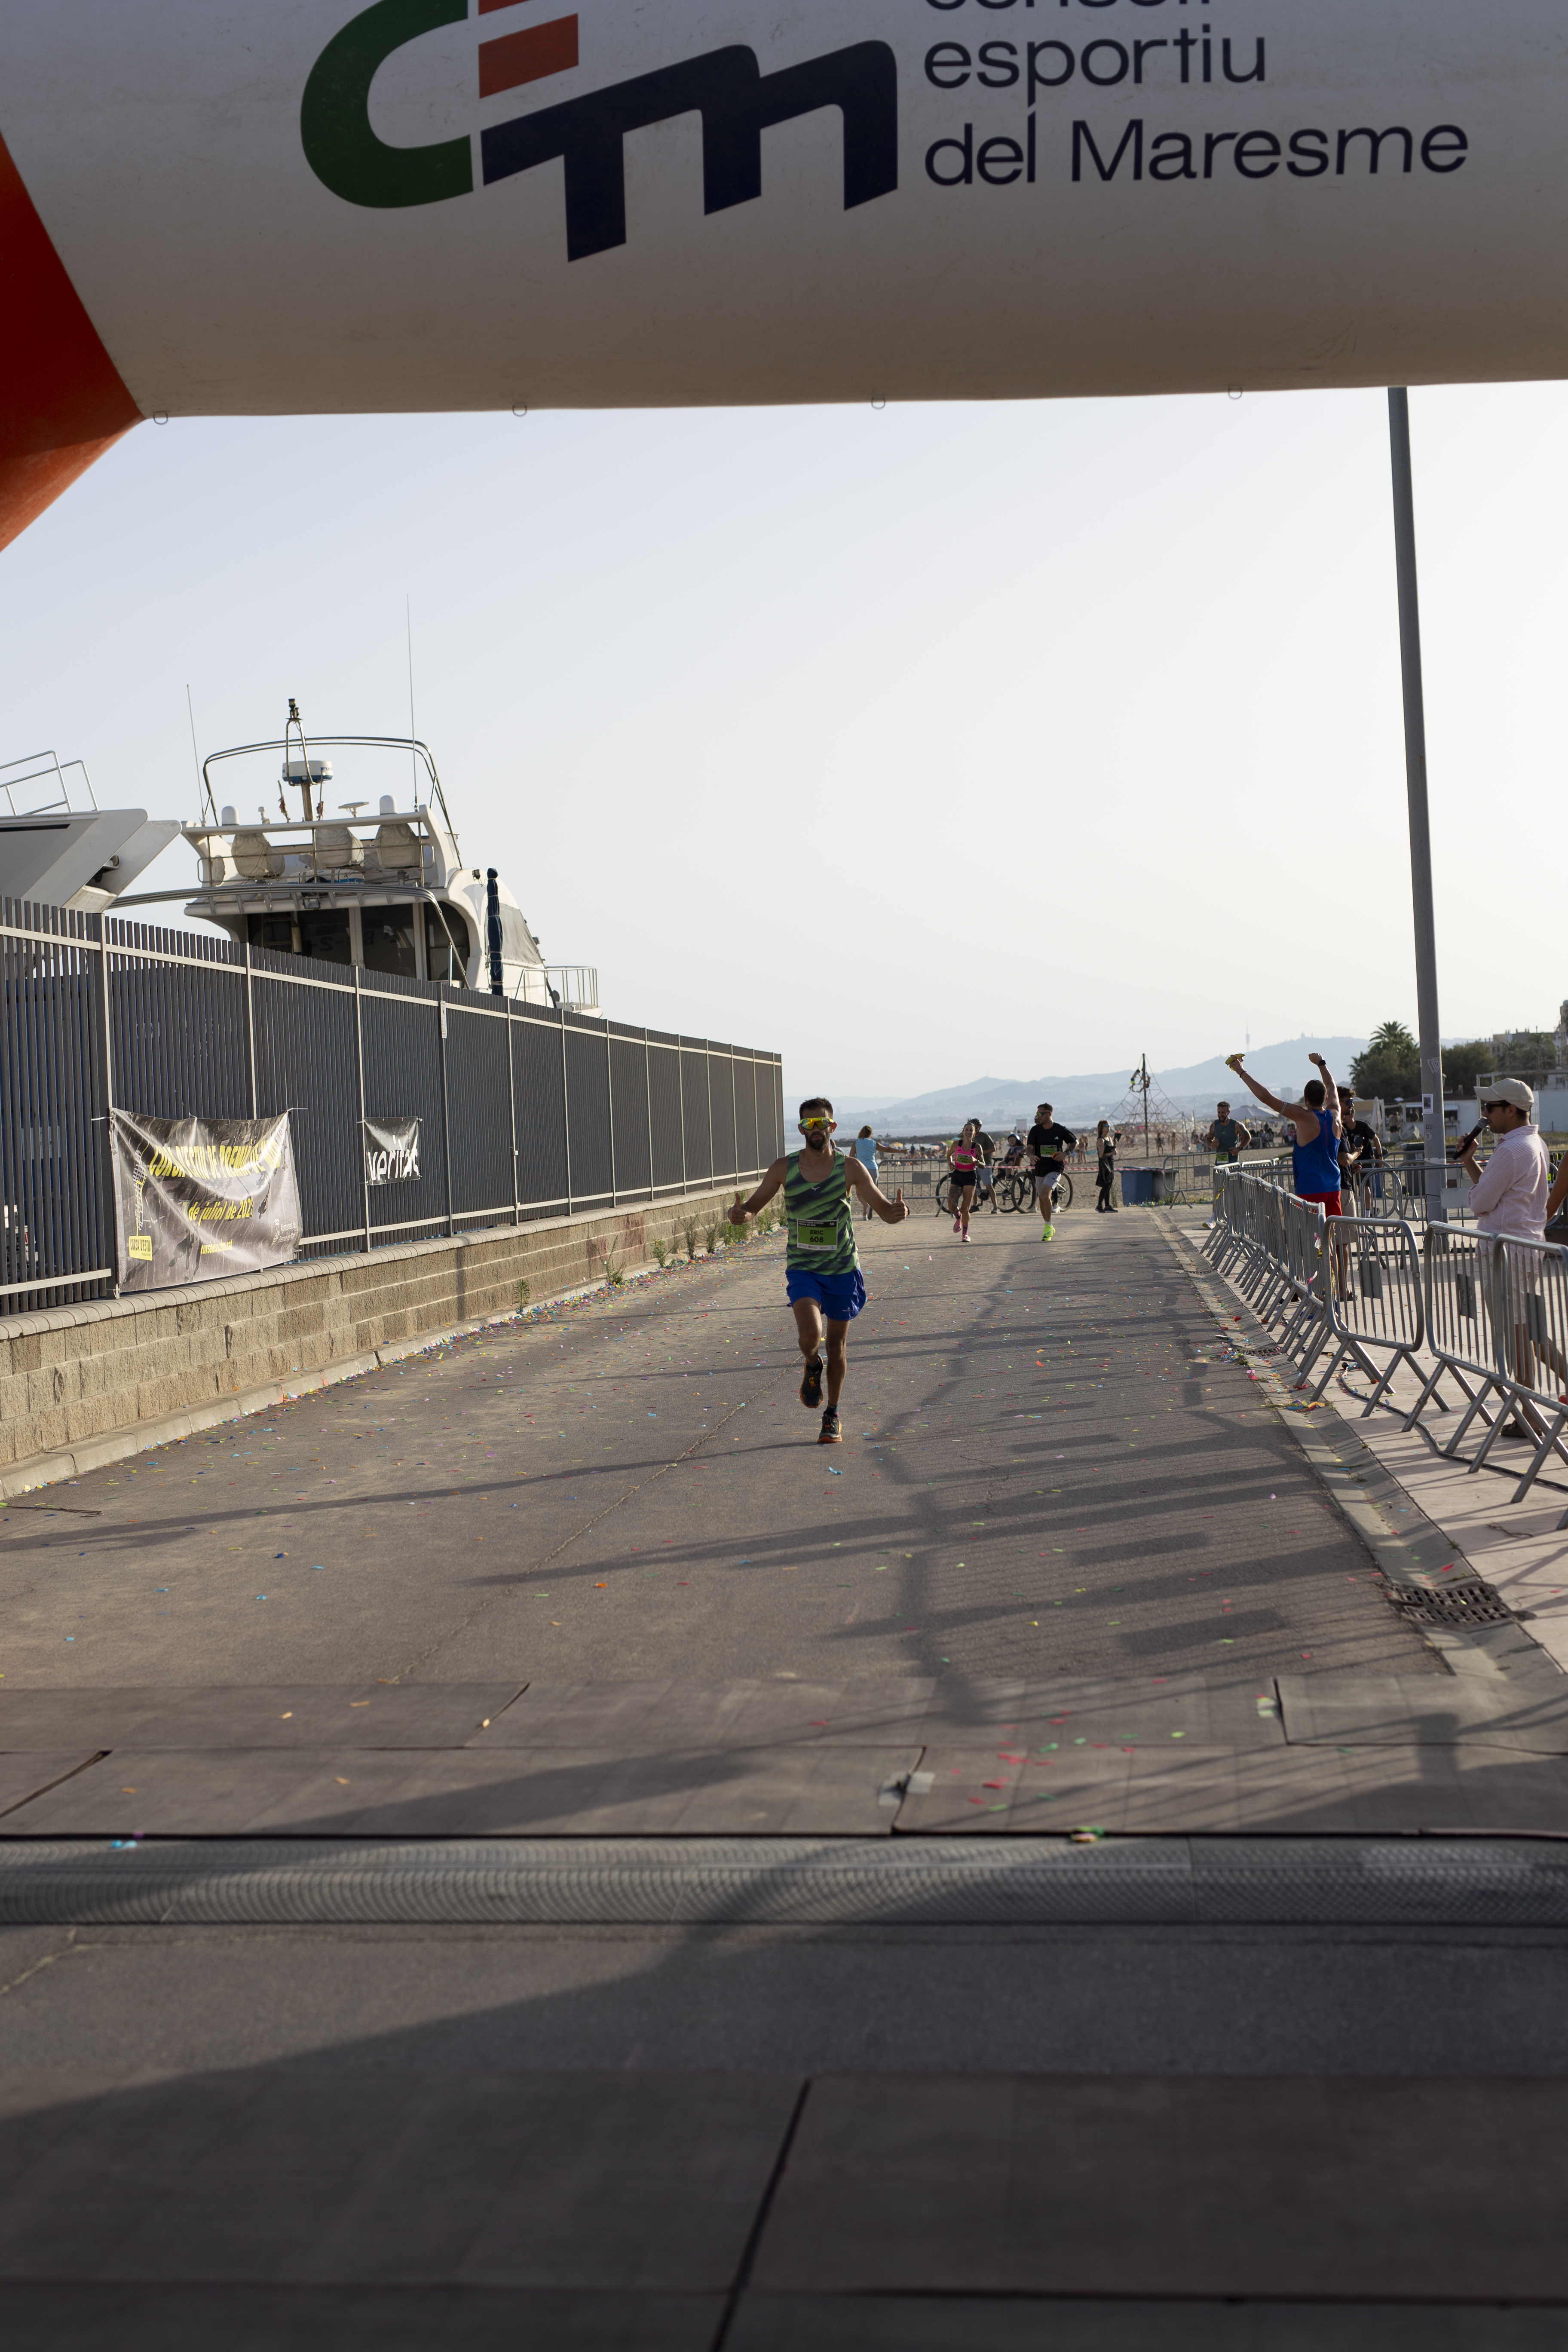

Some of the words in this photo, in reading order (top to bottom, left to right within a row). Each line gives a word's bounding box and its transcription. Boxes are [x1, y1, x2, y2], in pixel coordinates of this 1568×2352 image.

[924, 23, 1265, 107] esportiu
[925, 110, 1036, 186] del
[1072, 119, 1468, 181] Maresme
[207, 1145, 220, 1179] DE
[250, 1142, 266, 1174] DE
[188, 1201, 200, 1221] de
[198, 1201, 228, 1226] juliol
[225, 1200, 237, 1220] de
[130, 1238, 140, 1251] CURSA
[141, 1239, 151, 1253] D'ESTIU
